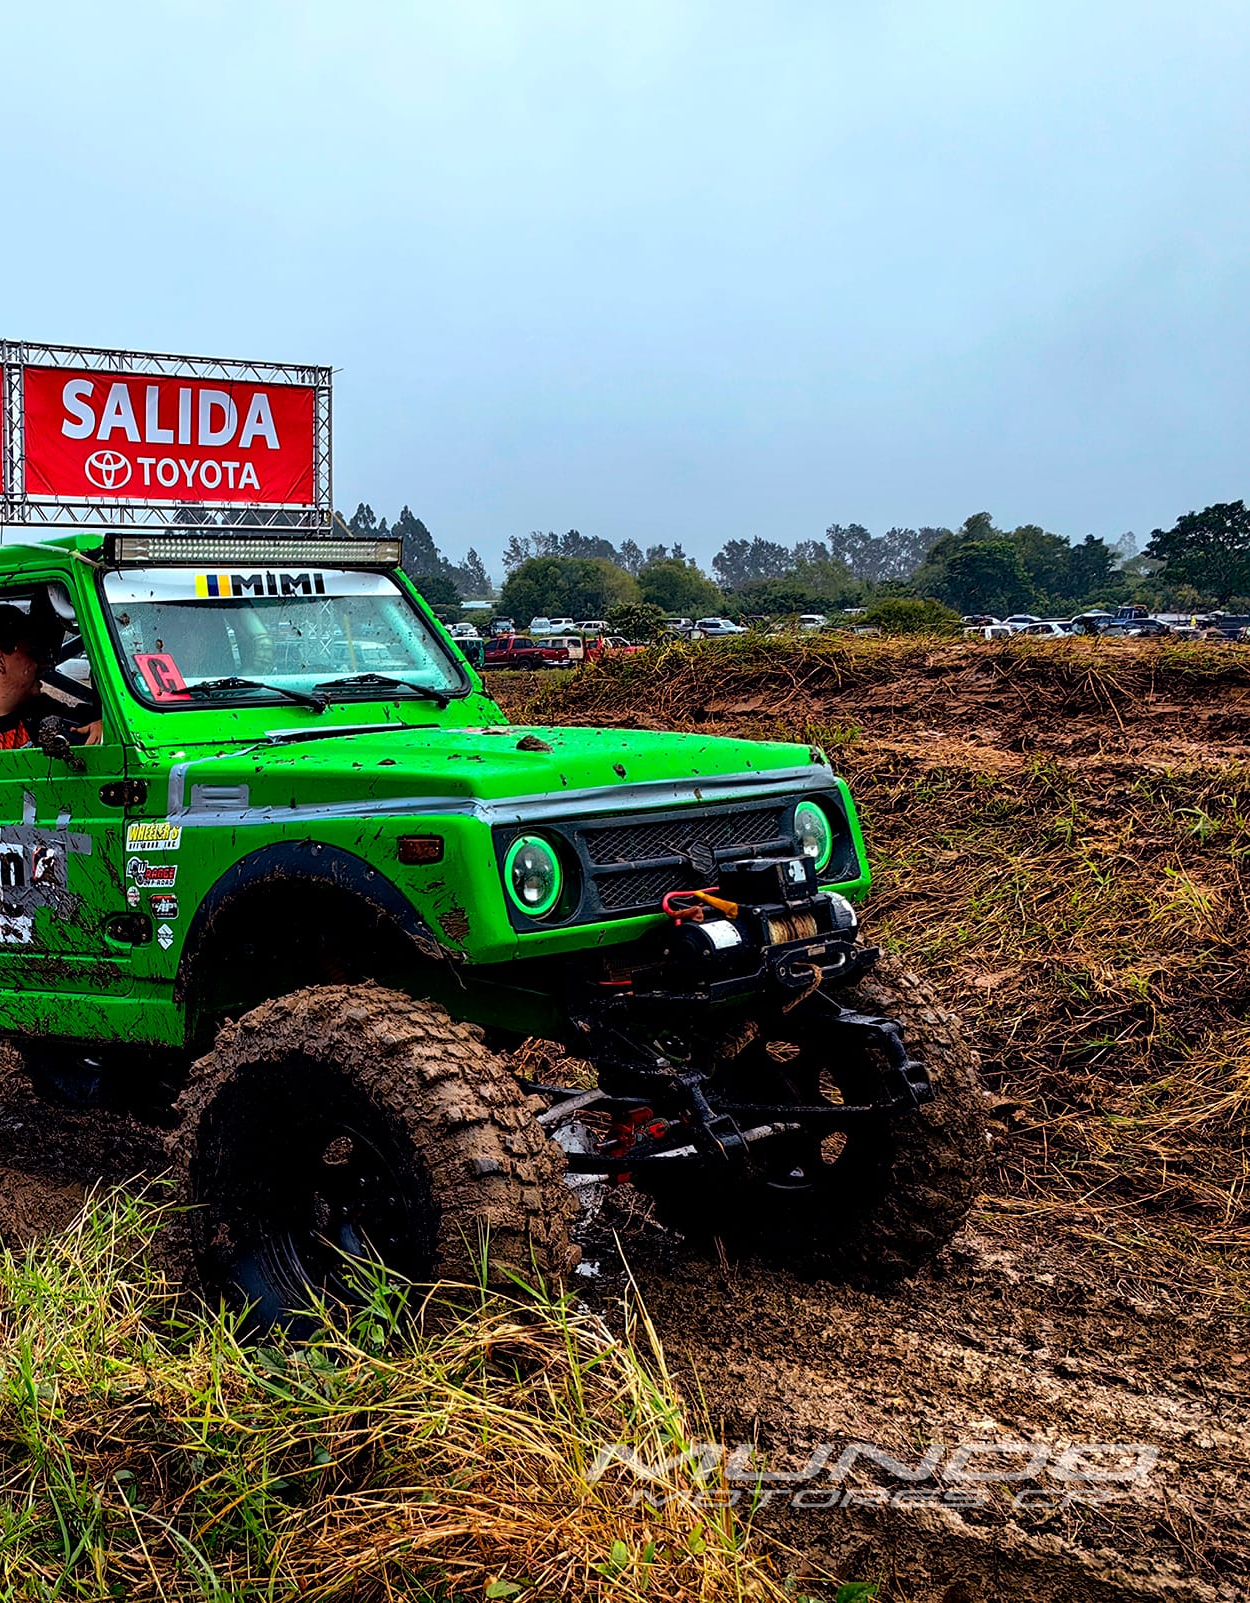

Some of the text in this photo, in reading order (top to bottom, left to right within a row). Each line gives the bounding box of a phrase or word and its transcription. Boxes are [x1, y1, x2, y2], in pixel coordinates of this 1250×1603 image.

[61, 378, 281, 451] SALIDA
[136, 456, 261, 490] TOYOTA
[230, 572, 326, 596] MIMI
[148, 659, 177, 693] C
[129, 824, 180, 842] WHEELERS
